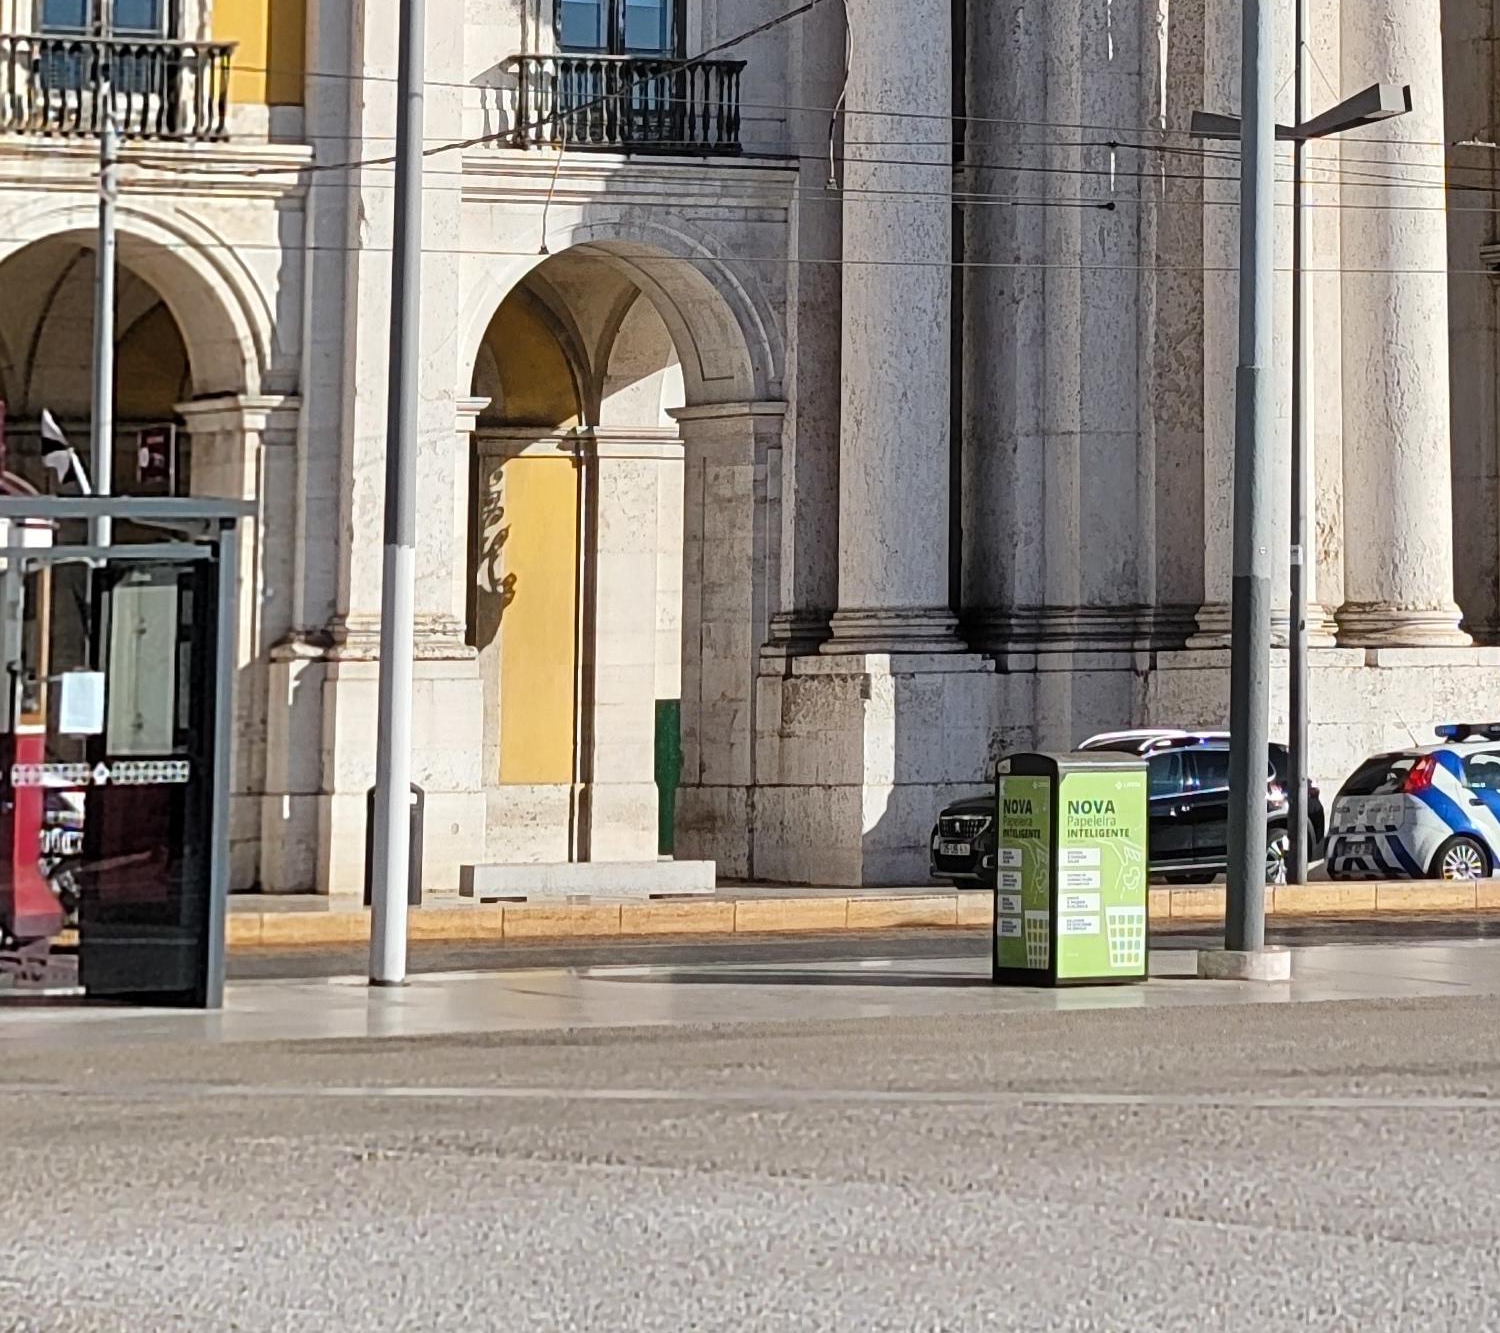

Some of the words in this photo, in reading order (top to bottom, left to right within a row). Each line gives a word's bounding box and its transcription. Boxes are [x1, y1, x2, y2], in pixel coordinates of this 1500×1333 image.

[1003, 799, 1033, 815] NOVA
[1067, 800, 1116, 814] NOVA
[1067, 815, 1117, 829] Papeleira
[1067, 828, 1130, 838] INTELIGENTE
